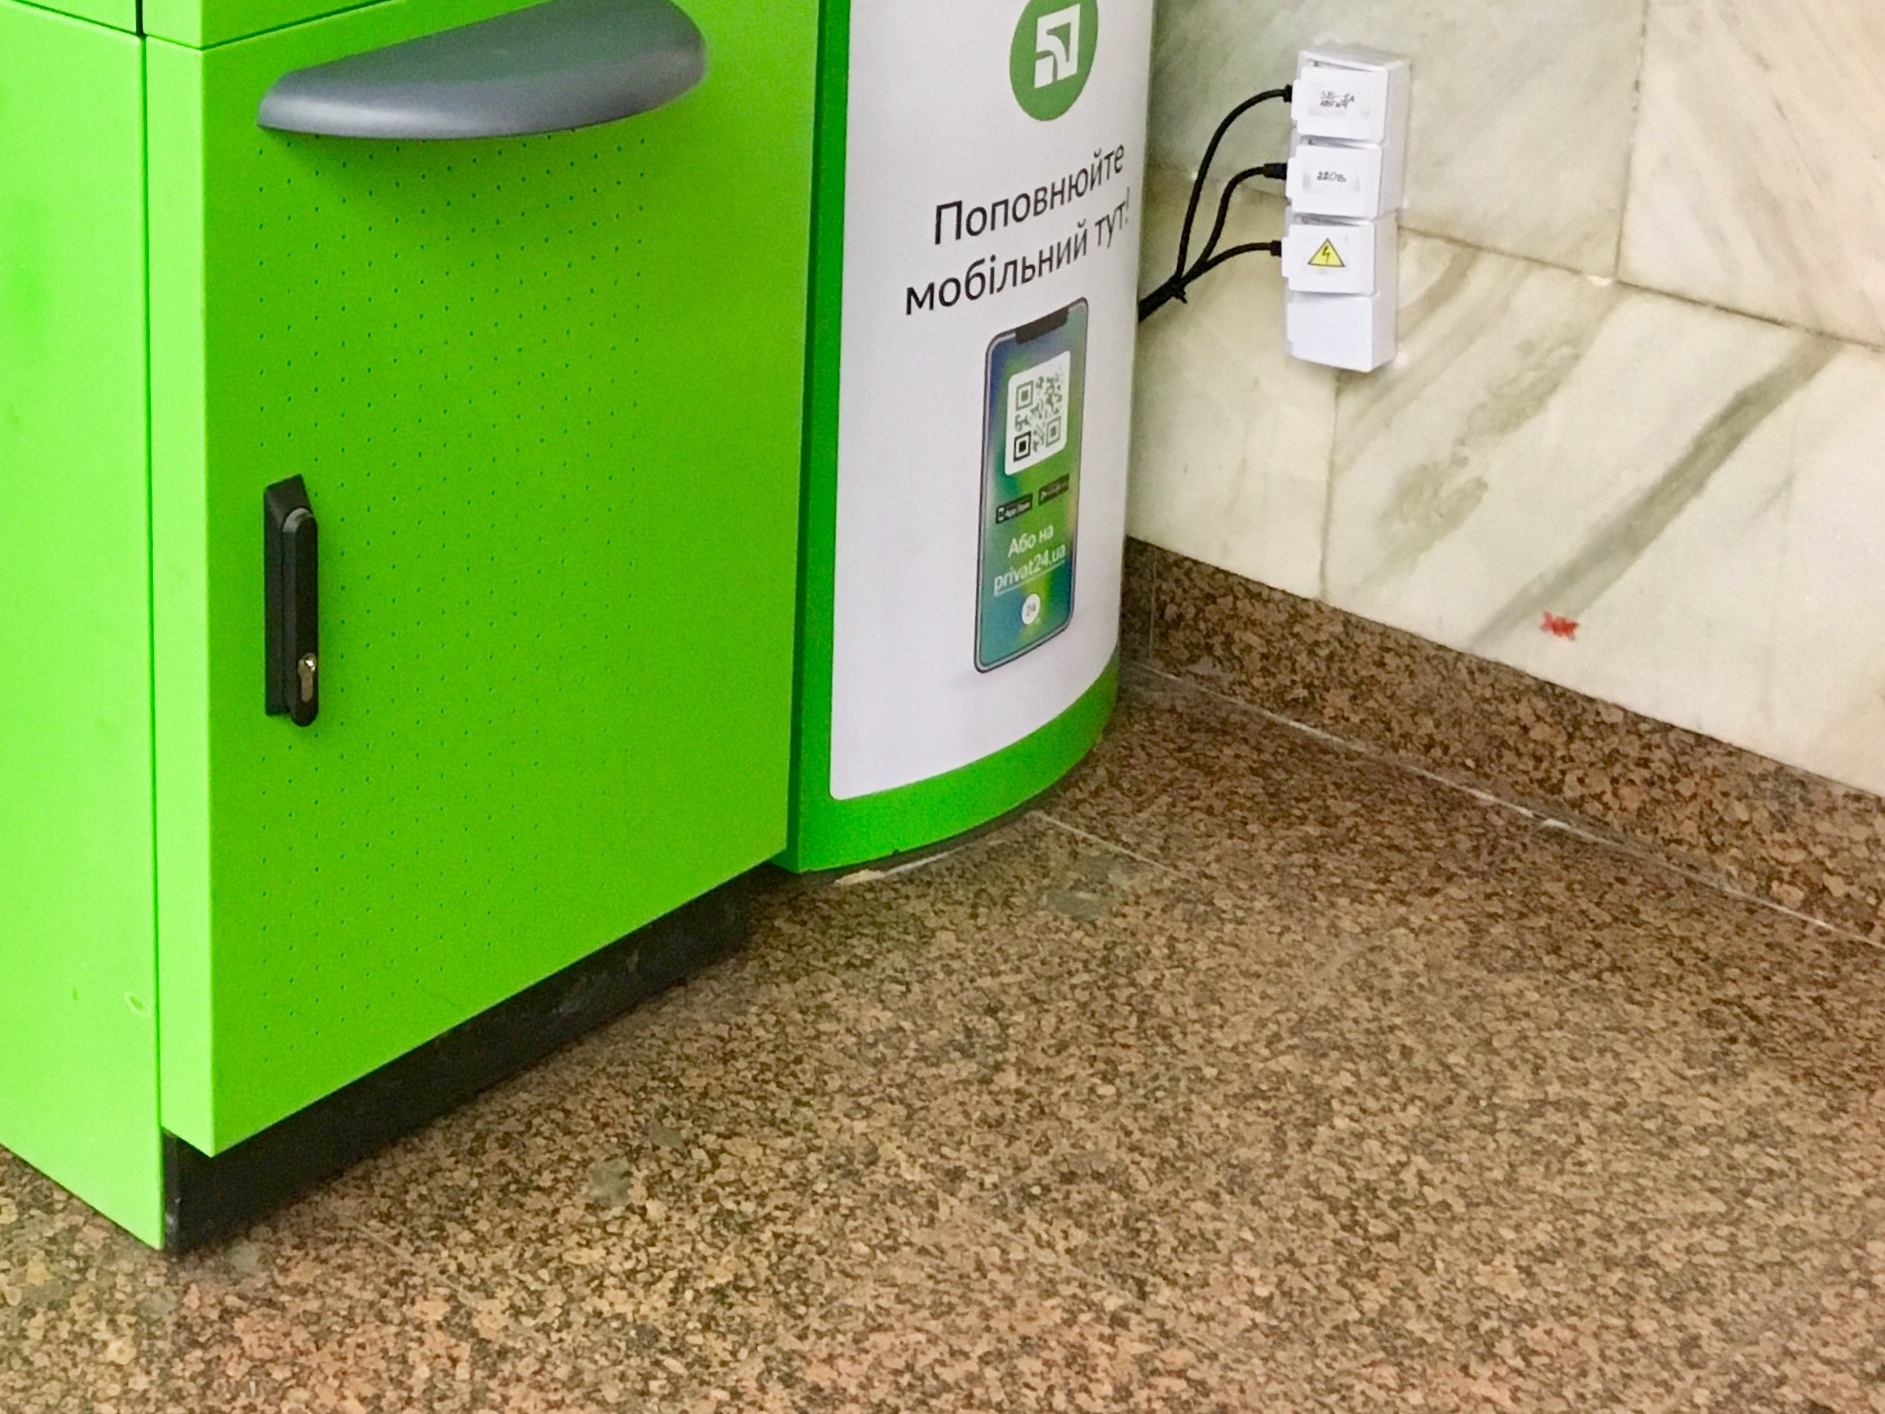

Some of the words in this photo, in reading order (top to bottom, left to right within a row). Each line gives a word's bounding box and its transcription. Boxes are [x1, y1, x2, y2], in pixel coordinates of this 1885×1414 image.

[935, 144, 1125, 245] Поповнюйте
[905, 218, 1087, 316] мобільний
[1094, 186, 1131, 248] тут!
[994, 543, 1066, 595] privat24.ua
[1007, 532, 1036, 557] Або
[1039, 524, 1054, 541] на
